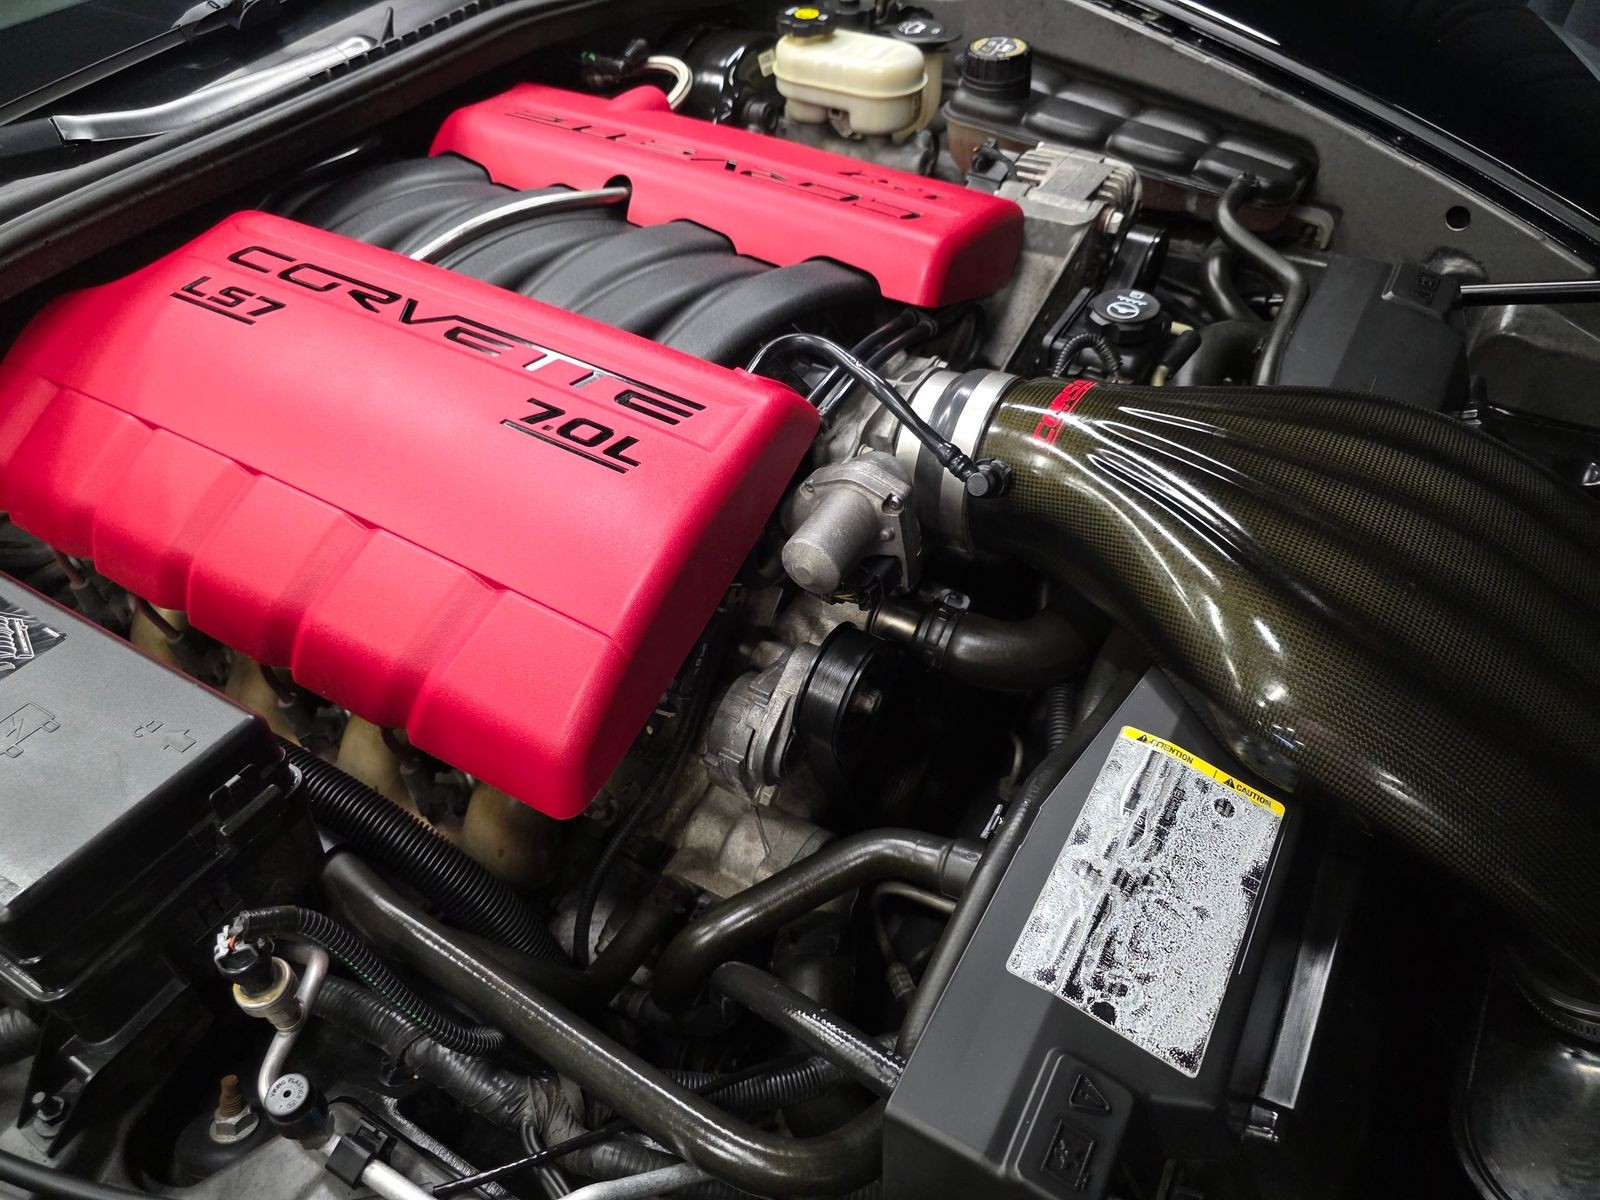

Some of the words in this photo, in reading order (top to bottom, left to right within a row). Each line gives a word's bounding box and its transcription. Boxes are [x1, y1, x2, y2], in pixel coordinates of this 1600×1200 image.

[181, 275, 287, 318] LS7
[228, 245, 707, 427] CORVETTE
[518, 397, 642, 468] 7.0L
[1235, 783, 1272, 808] CAUTION
[271, 1080, 287, 1097] VIKING
